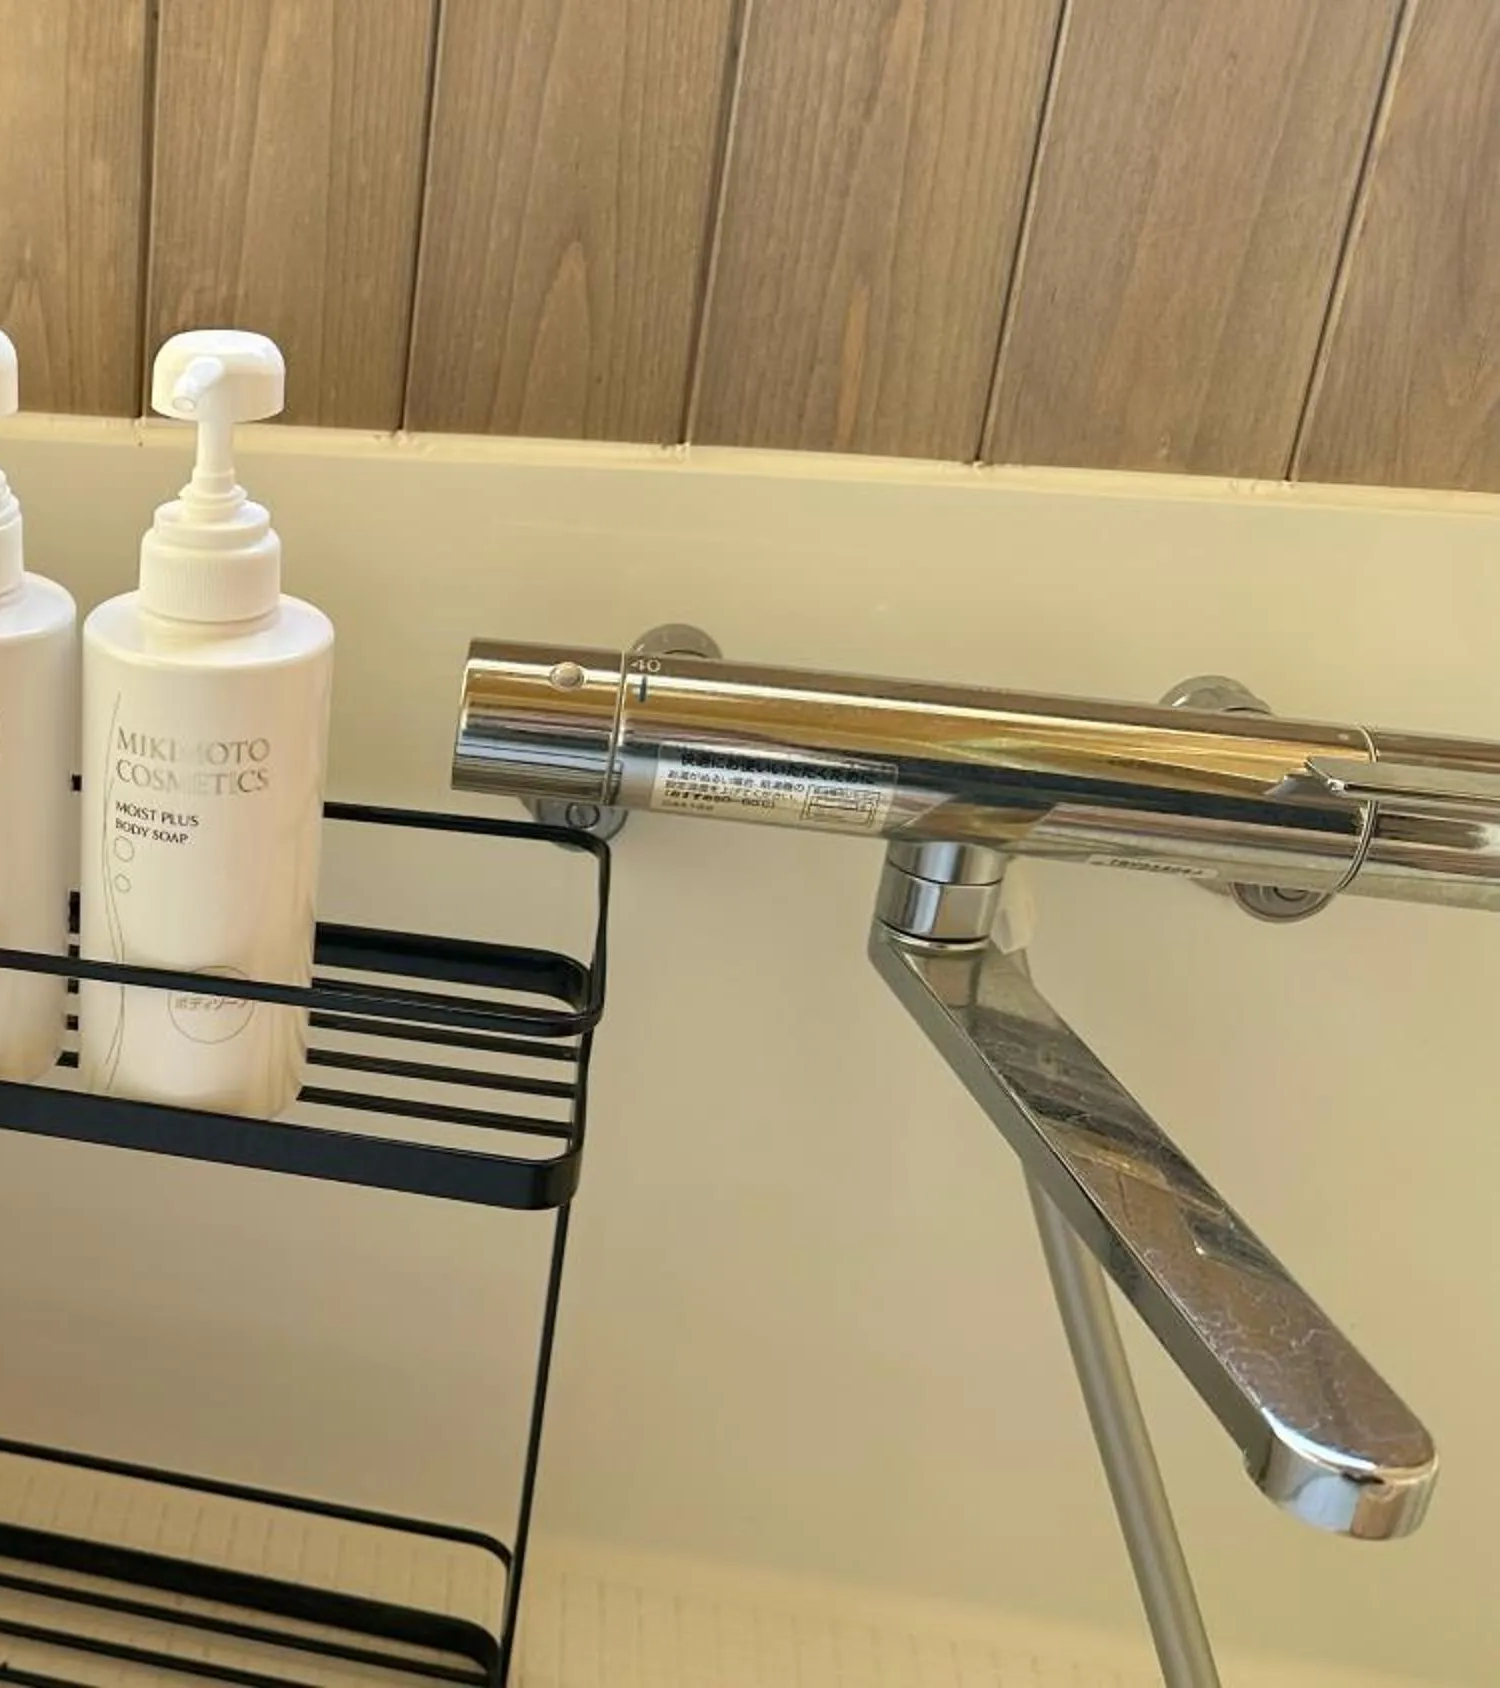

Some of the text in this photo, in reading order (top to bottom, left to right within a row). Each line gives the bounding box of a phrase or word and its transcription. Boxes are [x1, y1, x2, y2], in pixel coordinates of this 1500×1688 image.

[630, 659, 661, 673] 40
[117, 726, 270, 766] MIKIOTO
[115, 758, 270, 797] COSMETICS
[115, 801, 200, 828] MOIST PLUS
[115, 817, 189, 845] BODY SOAP
